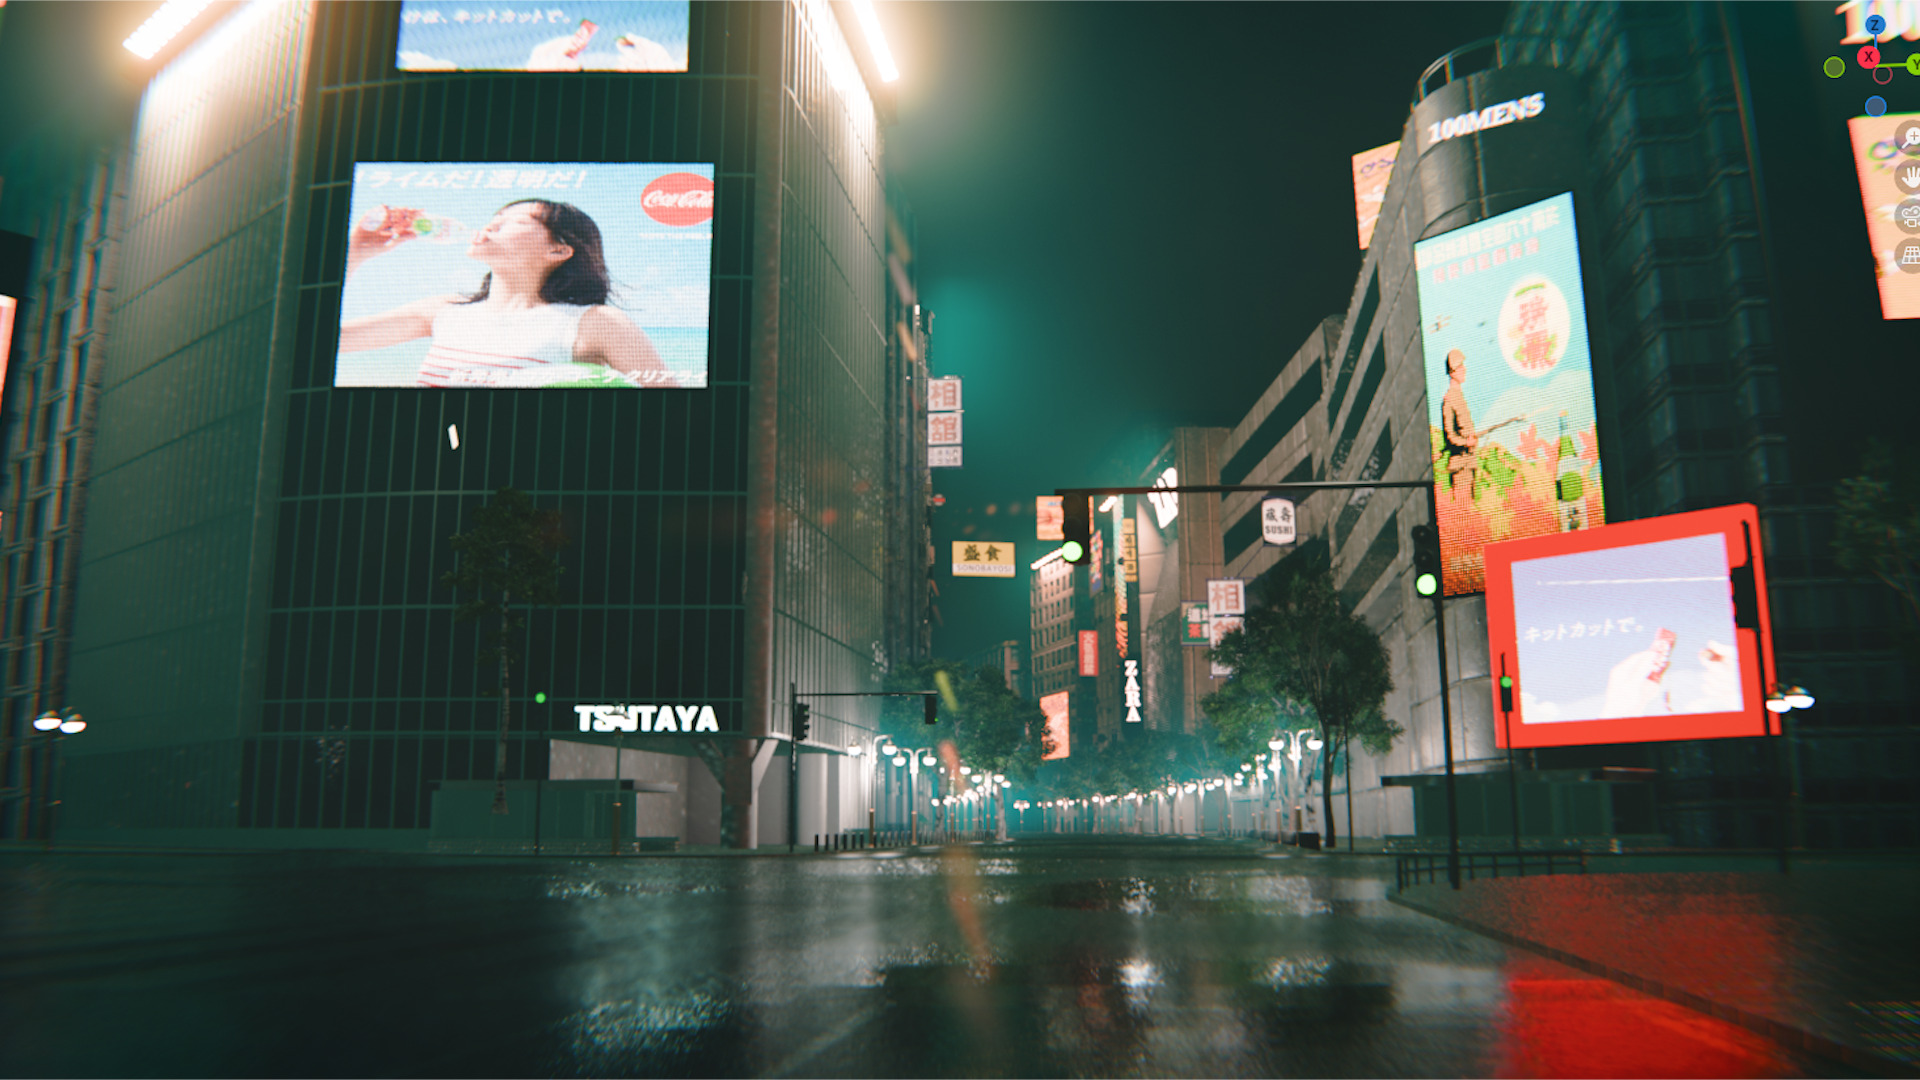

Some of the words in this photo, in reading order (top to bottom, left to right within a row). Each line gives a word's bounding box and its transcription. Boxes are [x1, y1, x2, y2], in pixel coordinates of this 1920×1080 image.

[1428, 91, 1546, 144] 100MENS
[1265, 525, 1293, 534] SUSHI
[1124, 659, 1142, 722] ZARA
[573, 704, 720, 732] TSUTAYA
